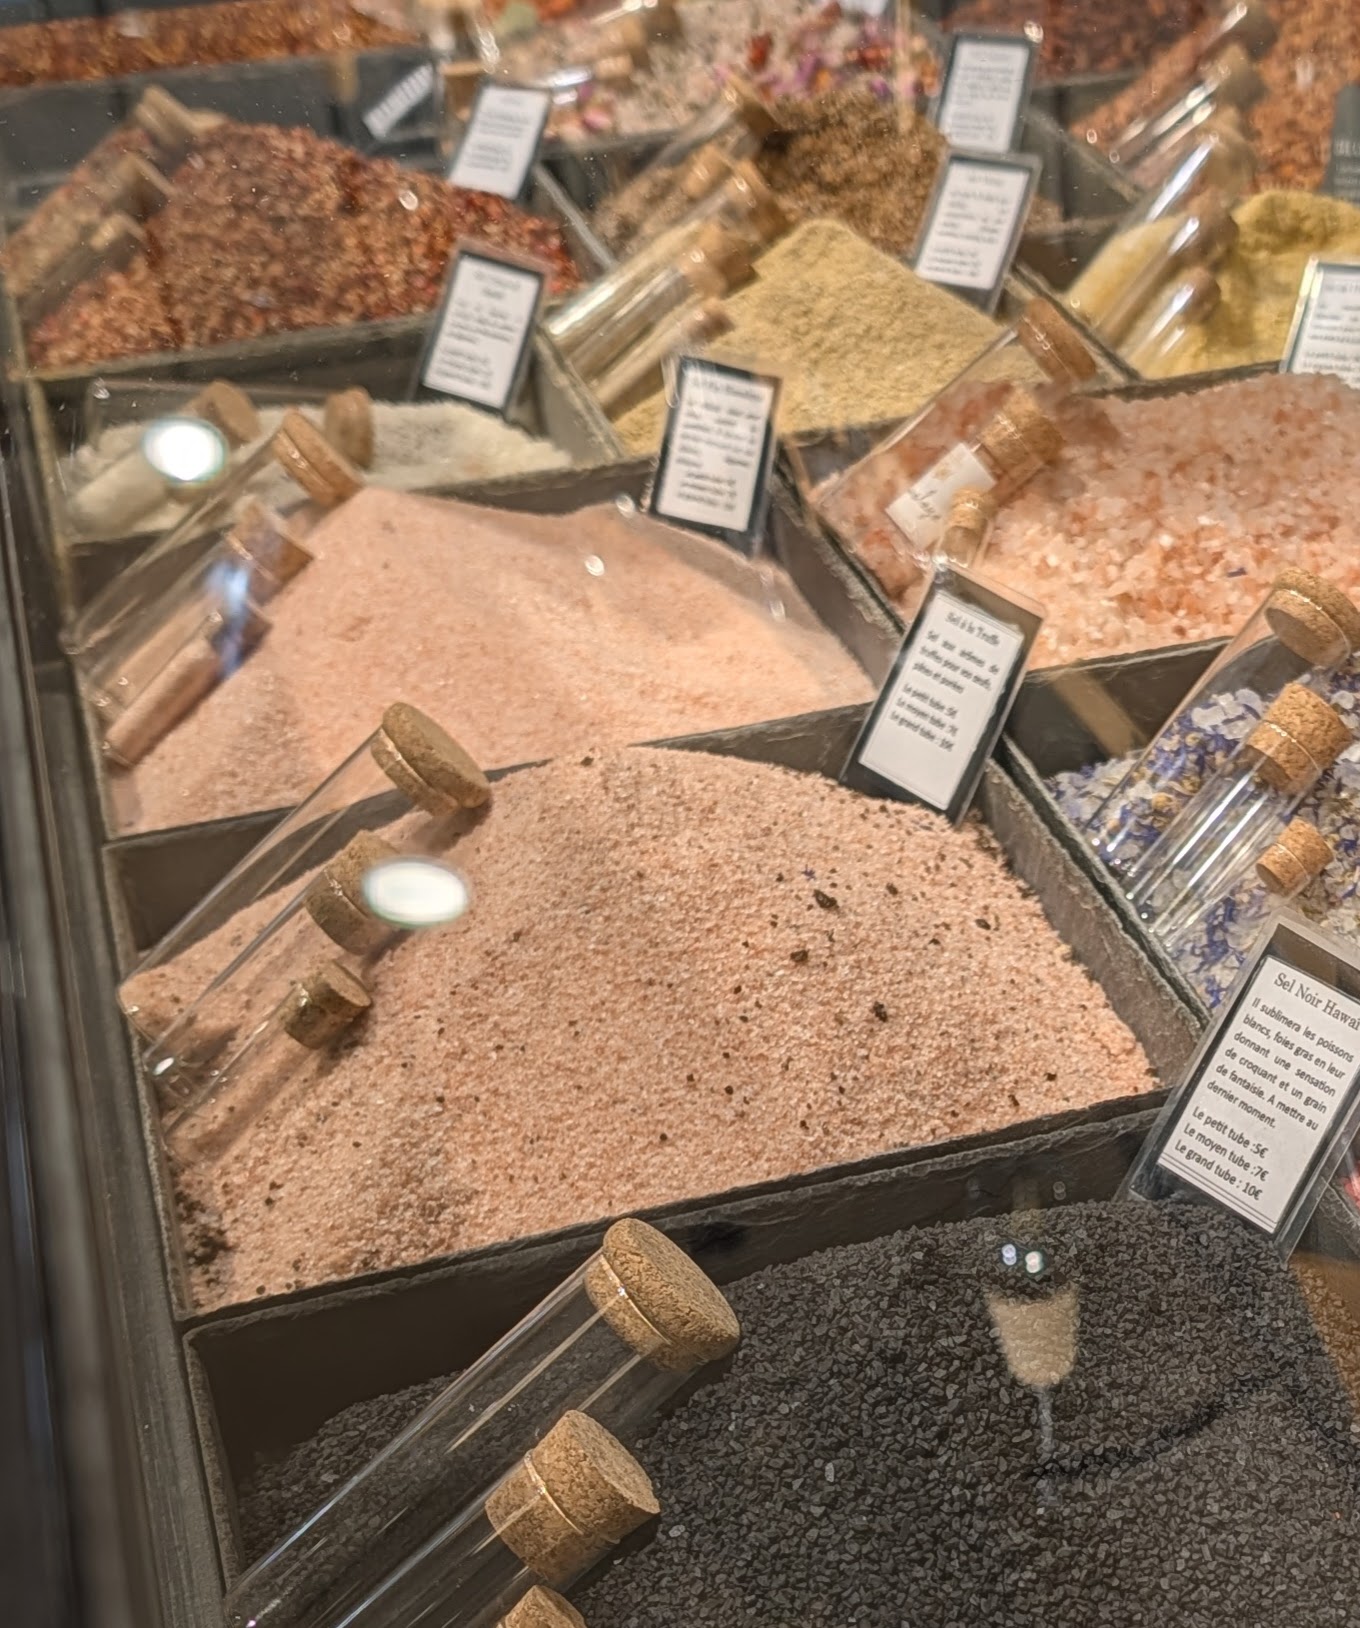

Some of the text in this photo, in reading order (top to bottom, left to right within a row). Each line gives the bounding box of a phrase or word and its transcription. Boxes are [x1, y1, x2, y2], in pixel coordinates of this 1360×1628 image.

[891, 711, 900, 722] Le
[920, 728, 936, 742] tube
[897, 698, 907, 708] Le
[930, 716, 946, 730] tube
[903, 684, 913, 694] Le
[912, 691, 930, 702] petit
[929, 698, 946, 712] tube
[1274, 973, 1297, 993] Sel
[1295, 984, 1323, 1009] Noir
[1243, 1014, 1346, 1079] blancs, foies gras en leur
[1252, 998, 1355, 1063] Il sublimera les poissons
[1225, 1048, 1327, 1114] de croquant et un grain
[1234, 1032, 1336, 1097] donnant une sensation
[1207, 1081, 1276, 1129] dernier moment.
[1216, 1065, 1319, 1131] de fantaisie. A mettre au
[1184, 1123, 1270, 1182] Le moyen tube :7€
[1192, 1106, 1269, 1159] Le petit tube :5€
[1175, 1140, 1187, 1154] Le
[1185, 1150, 1216, 1171] grand
[1214, 1165, 1237, 1186] tube
[1242, 1182, 1263, 1201] 10€
